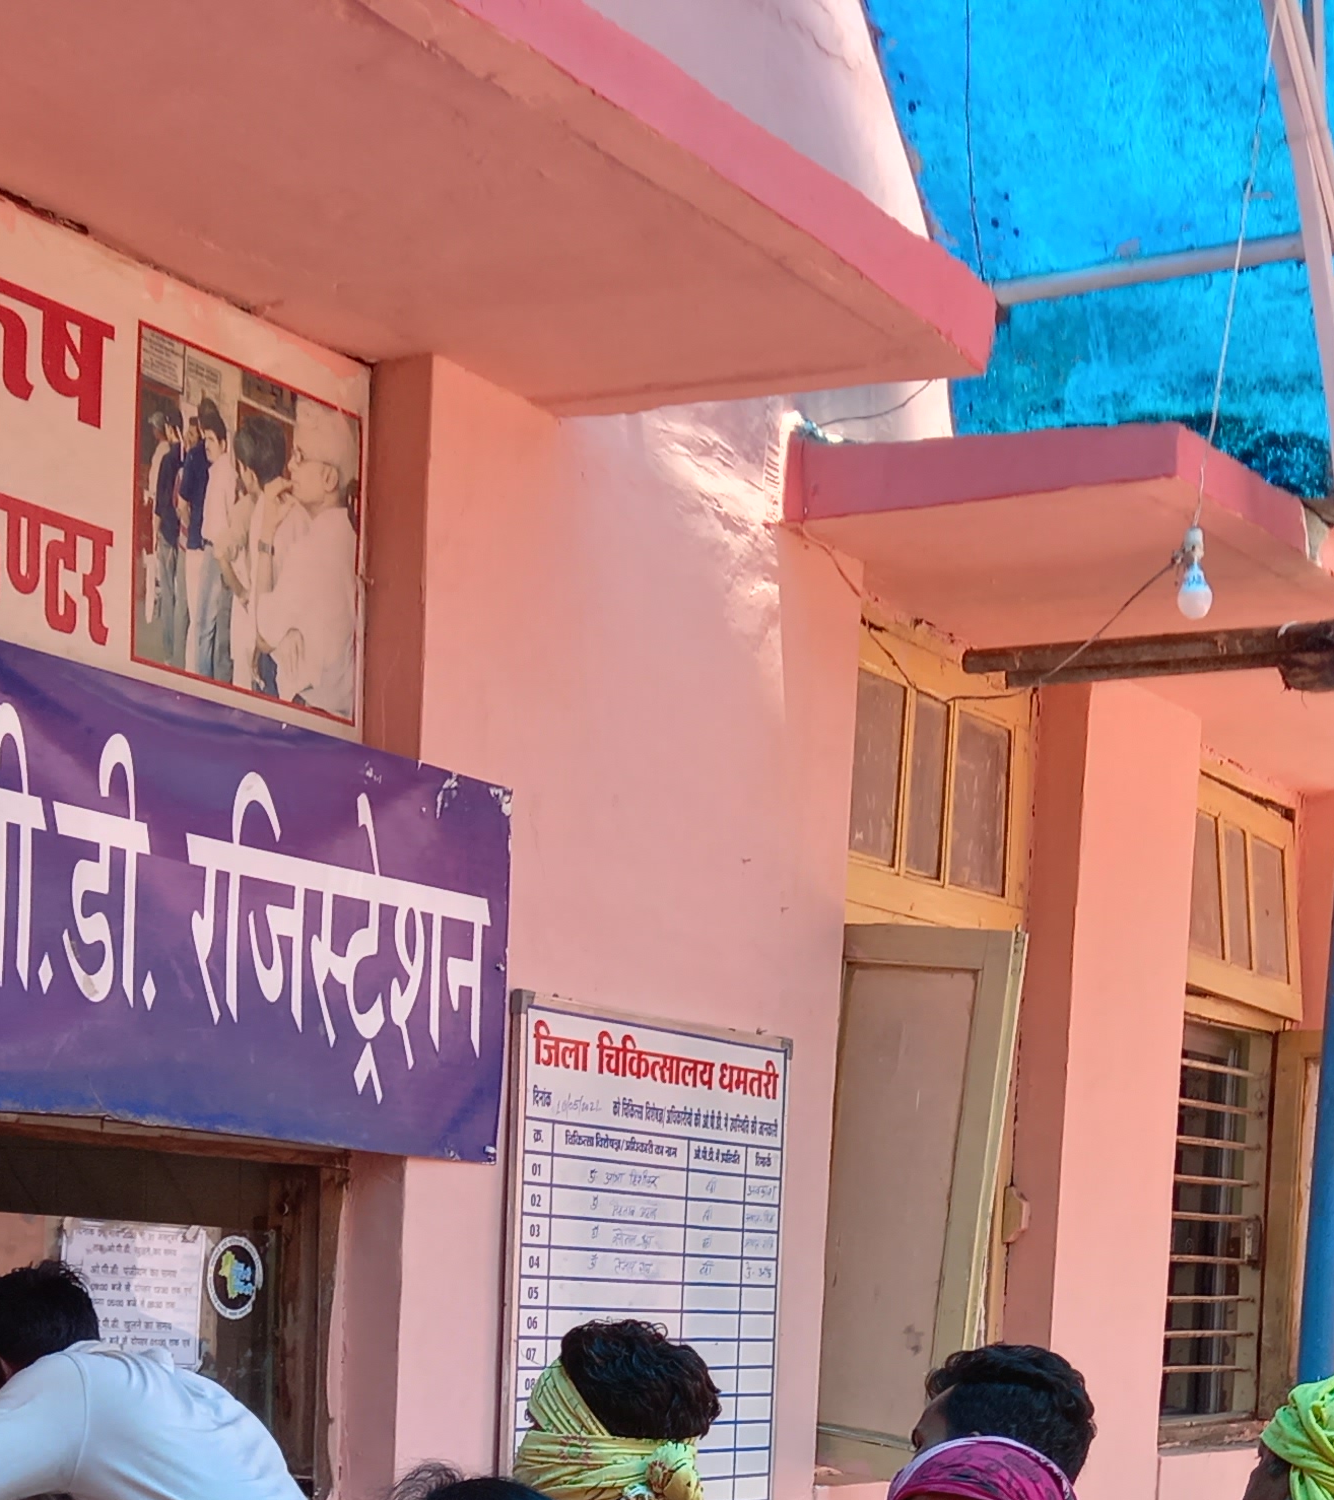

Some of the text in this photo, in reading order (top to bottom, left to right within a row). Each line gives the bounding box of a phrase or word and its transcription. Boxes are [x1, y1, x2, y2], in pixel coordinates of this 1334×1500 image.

[185, 771, 492, 1105] रजिस्ट्रेशन
[533, 1019, 779, 1100] जिला चिकित्सालय धमतरी
[531, 1163, 542, 1177] 01
[530, 1193, 542, 1207] 02
[529, 1224, 541, 1238] 03
[528, 1255, 540, 1269] 04
[527, 1286, 539, 1299] 05
[526, 1316, 538, 1330] 06
[525, 1347, 537, 1361] 07
[524, 1377, 535, 1391] 08
